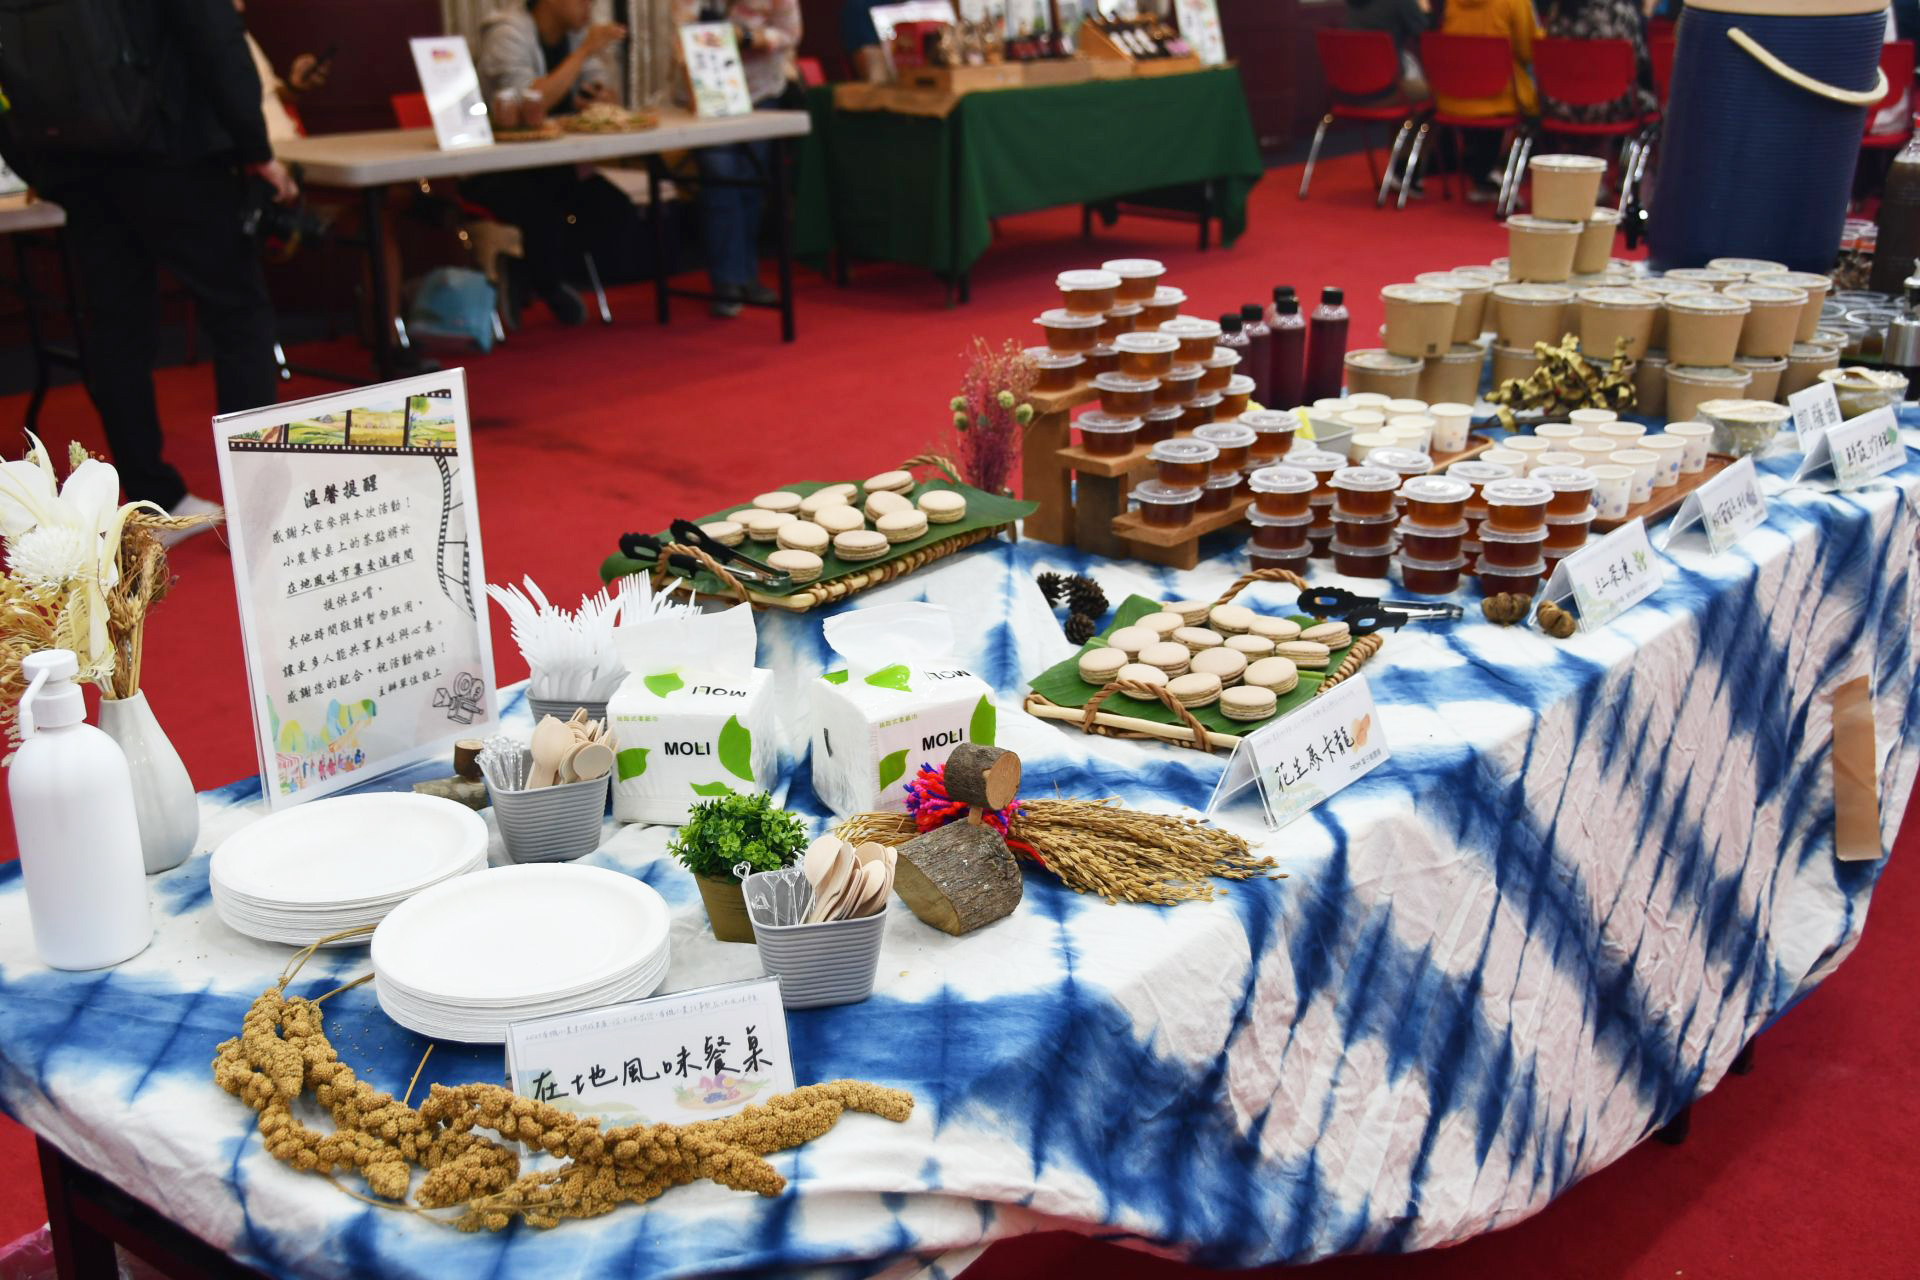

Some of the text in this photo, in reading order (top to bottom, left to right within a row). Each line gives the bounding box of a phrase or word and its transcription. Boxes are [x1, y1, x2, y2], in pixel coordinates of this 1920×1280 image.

[283, 523, 412, 567] 小農餐桌上的茶點將於
[692, 685, 747, 698] MOLI
[664, 741, 712, 757] MOLI
[922, 727, 963, 751] MOLI
[1274, 726, 1355, 792] 花生馬卡龍
[532, 1025, 773, 1103] 在地風味餐桌
